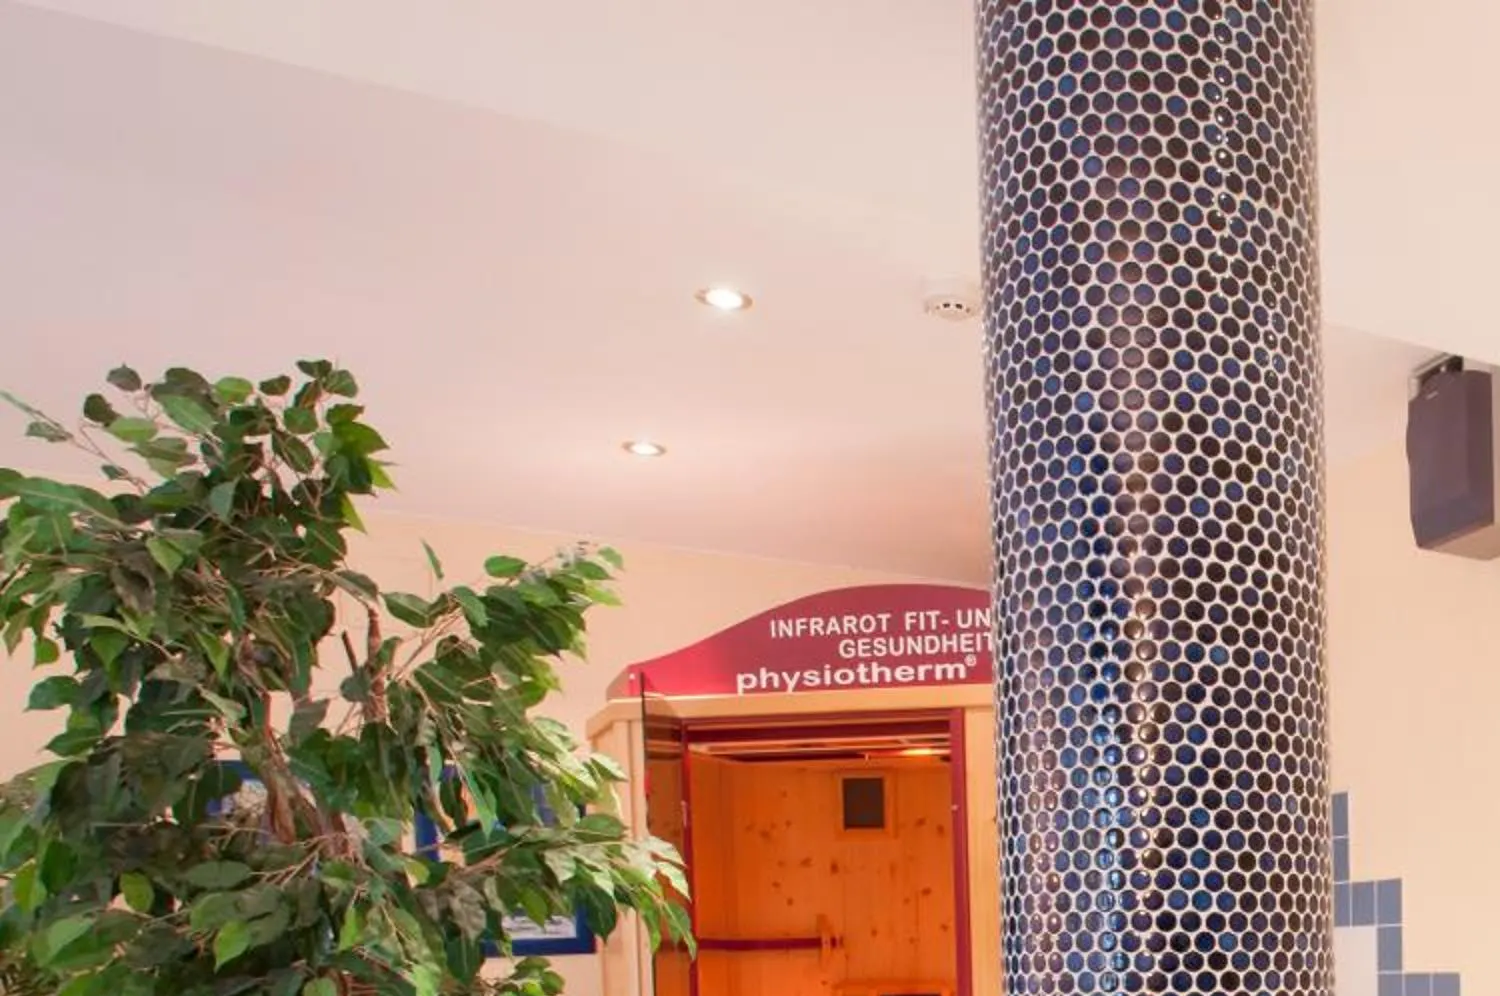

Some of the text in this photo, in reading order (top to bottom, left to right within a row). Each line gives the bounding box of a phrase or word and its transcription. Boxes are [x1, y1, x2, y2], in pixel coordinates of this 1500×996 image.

[769, 613, 891, 638] INFRAROT
[904, 611, 949, 631] FIT-
[838, 631, 993, 659] GESUNDHEIT
